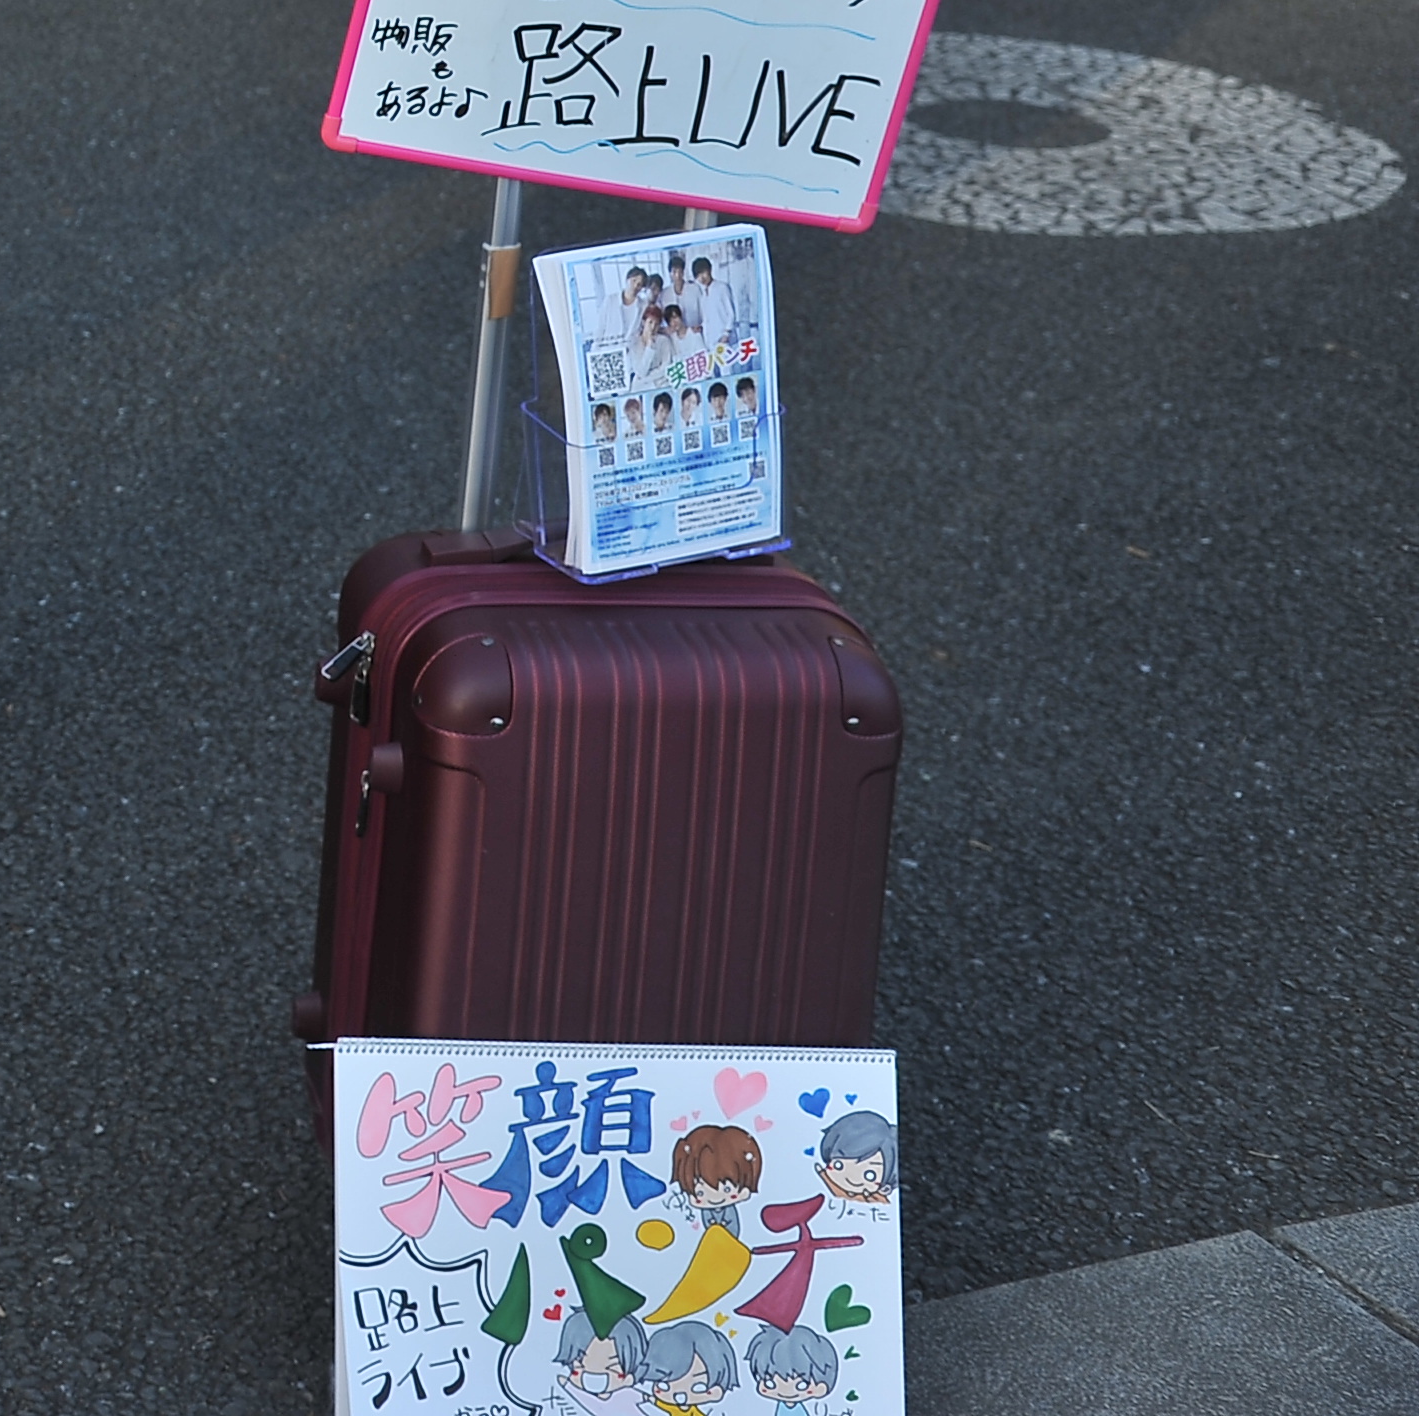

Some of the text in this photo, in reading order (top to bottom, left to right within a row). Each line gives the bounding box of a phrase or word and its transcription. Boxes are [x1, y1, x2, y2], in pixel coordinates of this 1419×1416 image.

[371, 16, 458, 57] 物販
[431, 60, 453, 79] も
[666, 337, 759, 390] 笑顔パンチ
[355, 1060, 668, 1239] 笑顔
[481, 1193, 865, 1346] パンチ
[353, 1285, 465, 1352] 路上
[357, 1347, 471, 1410] ライブ
